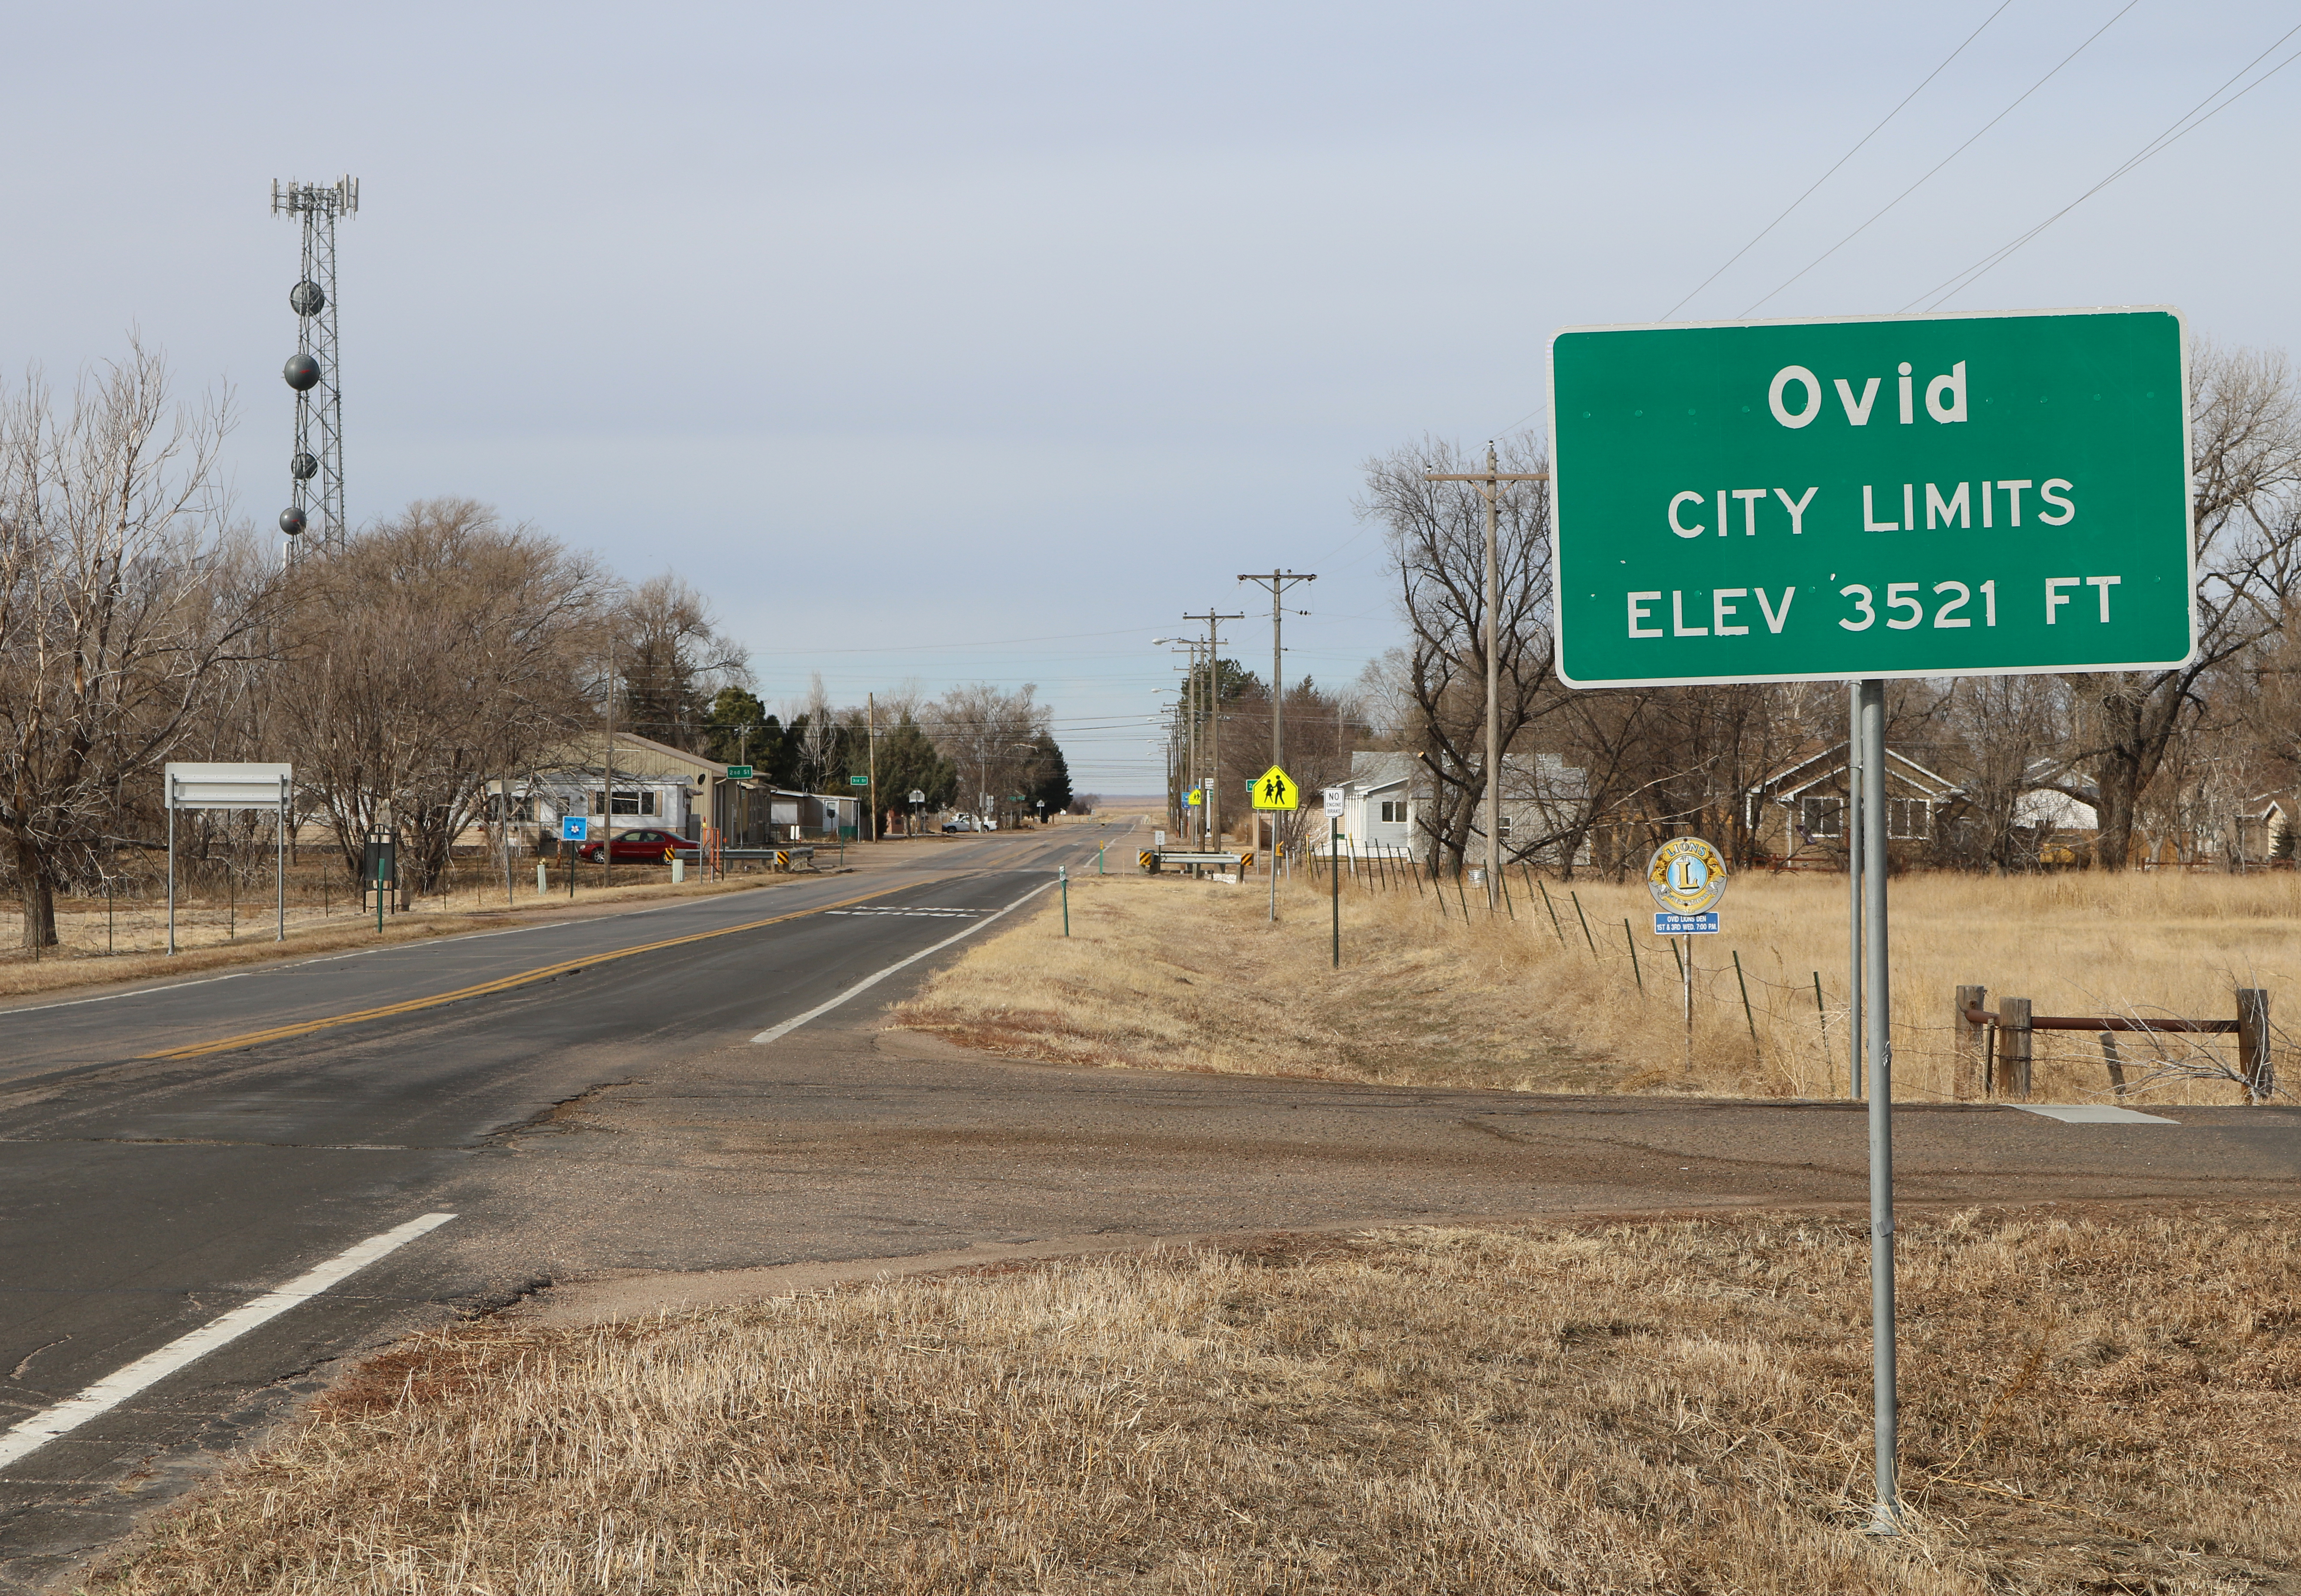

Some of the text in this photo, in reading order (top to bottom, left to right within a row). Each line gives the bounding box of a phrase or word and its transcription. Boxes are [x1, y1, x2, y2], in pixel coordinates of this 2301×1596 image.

[1769, 360, 1967, 429] Ovid
[1669, 479, 2075, 538] CITY LIMITS
[1628, 576, 2121, 638] ELEV 3521 FT
[1329, 792, 1339, 801] NO
[1666, 842, 1706, 857] LIONS
[1676, 862, 1699, 889] L
[1666, 891, 1711, 905] INTERNATIONAL
